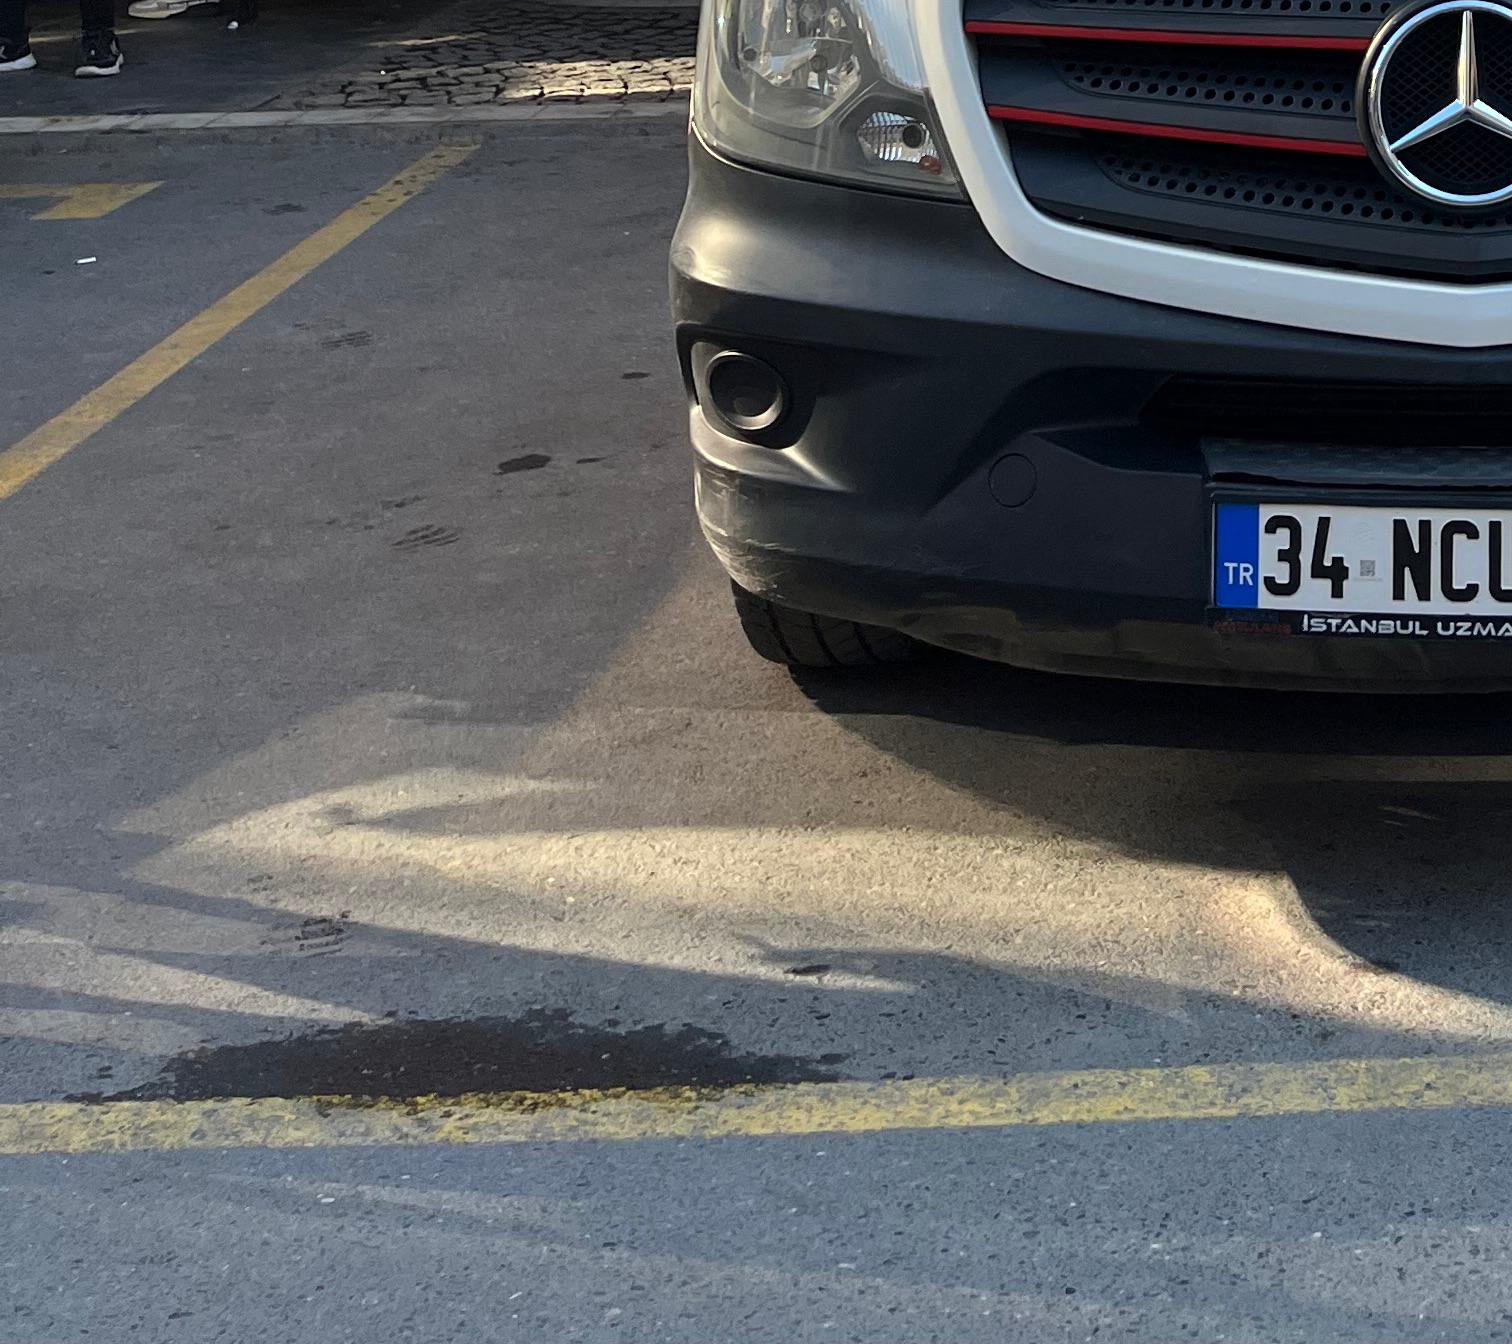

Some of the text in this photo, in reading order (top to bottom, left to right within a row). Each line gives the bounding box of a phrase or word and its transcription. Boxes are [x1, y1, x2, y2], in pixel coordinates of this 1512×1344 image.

[1223, 562, 1253, 585] TR
[1263, 515, 1349, 599] 34
[1302, 614, 1429, 636] İSTANBUL
